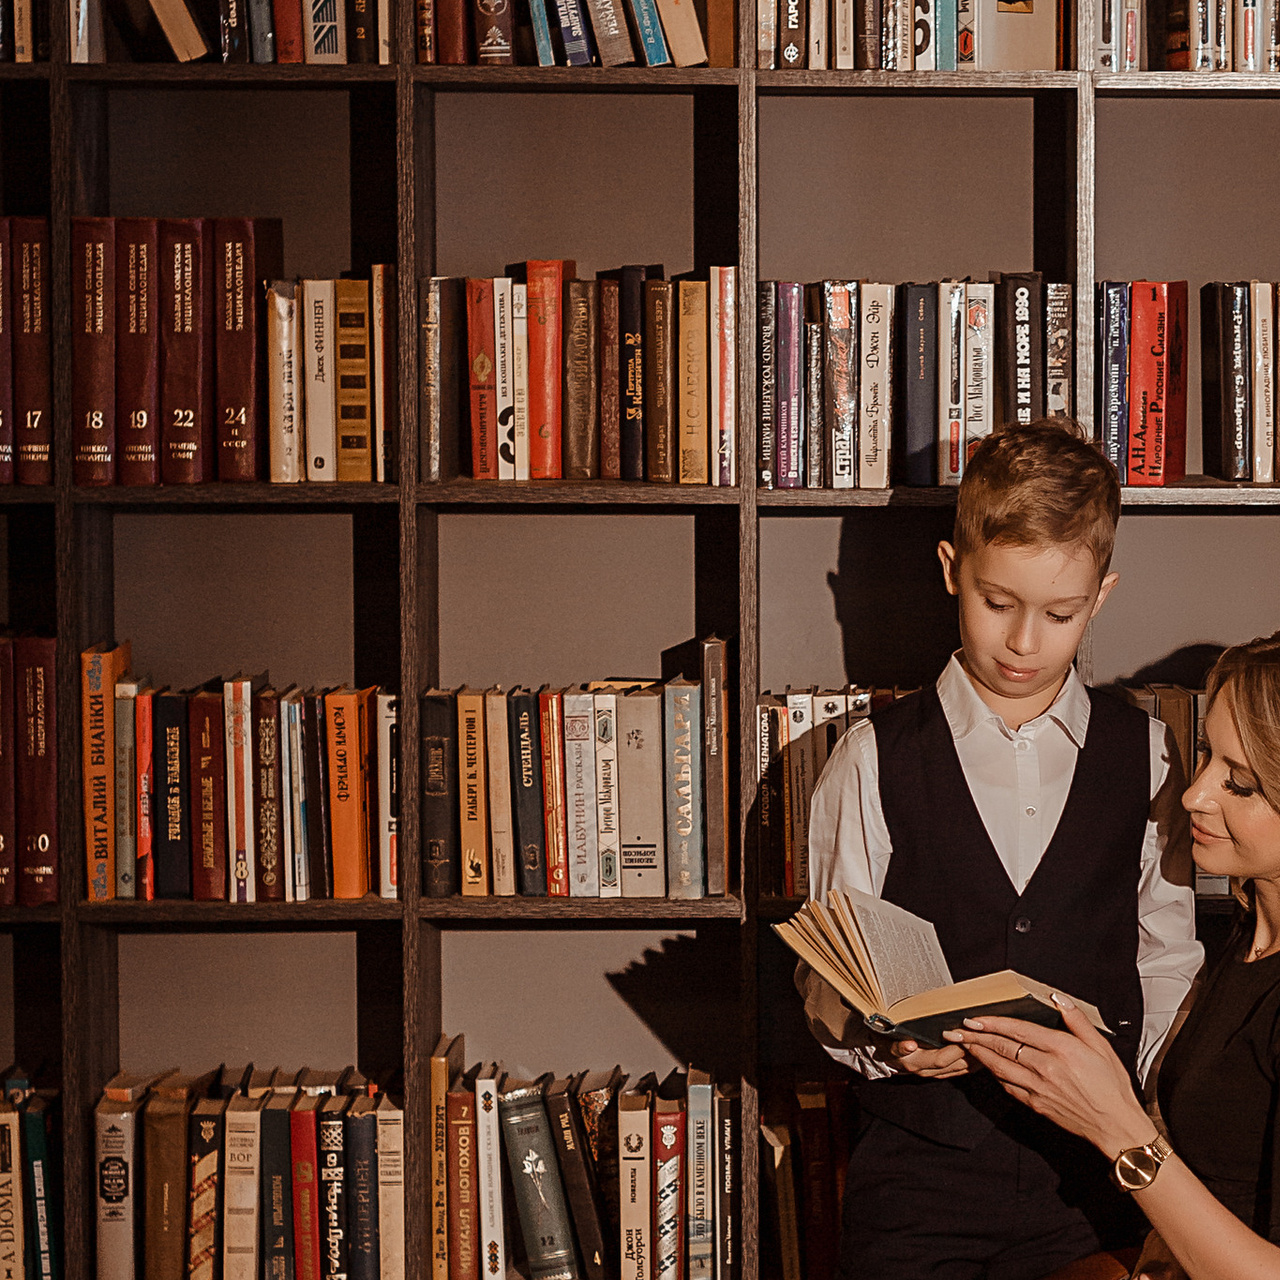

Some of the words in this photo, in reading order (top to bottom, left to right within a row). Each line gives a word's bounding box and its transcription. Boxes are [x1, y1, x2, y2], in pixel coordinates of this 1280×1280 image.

[356, 27, 366, 39] 2
[95, 242, 104, 333] ЭНЦИКЛОПЕДИЯ
[139, 243, 147, 333] ЭНЦИКЛОПЕДИЯ
[184, 243, 192, 332] ЭНЦИКЛОПЕДИЯ
[234, 242, 243, 330] ЭНЦИКЛОПЕДИЯ
[1015, 288, 1029, 321] 1990
[313, 299, 324, 352] ФИННЕЙ
[498, 292, 506, 341] ДЕТЕКТИВА
[499, 342, 507, 384] КОПИЛКИ
[1016, 324, 1030, 364] МОРЕ
[313, 355, 325, 382] Джек
[1018, 368, 1030, 389] НА
[1108, 363, 1120, 412] времени
[1263, 363, 1271, 417] ВИНОГРАДНИК
[761, 365, 771, 420] РОЖДЕНИЕ
[1018, 392, 1030, 403] И
[27, 410, 43, 429] 17
[86, 410, 104, 429] 18
[130, 410, 148, 429] 19
[173, 408, 194, 428] 22
[225, 407, 246, 425] 24
[761, 423, 771, 460] ИМЕНИ
[90, 693, 105, 765] БИАНКИ
[466, 717, 477, 768] ЧЕСТЕРТОН
[520, 712, 532, 787] СТЕНДАЛЬ
[674, 694, 693, 836] САЛЬГАРИ
[92, 775, 109, 860] ВИТАЛИЙ
[460, 1106, 468, 1118] 7
[696, 1120, 704, 1139] ВЕКЕ
[458, 1126, 470, 1203] ШОЛОХОВ
[695, 1142, 705, 1188] КАМЕННОМ
[696, 1198, 705, 1220] БЫЛО
[459, 1209, 470, 1274] МИХАИЛ
[625, 1229, 635, 1260] Джон
